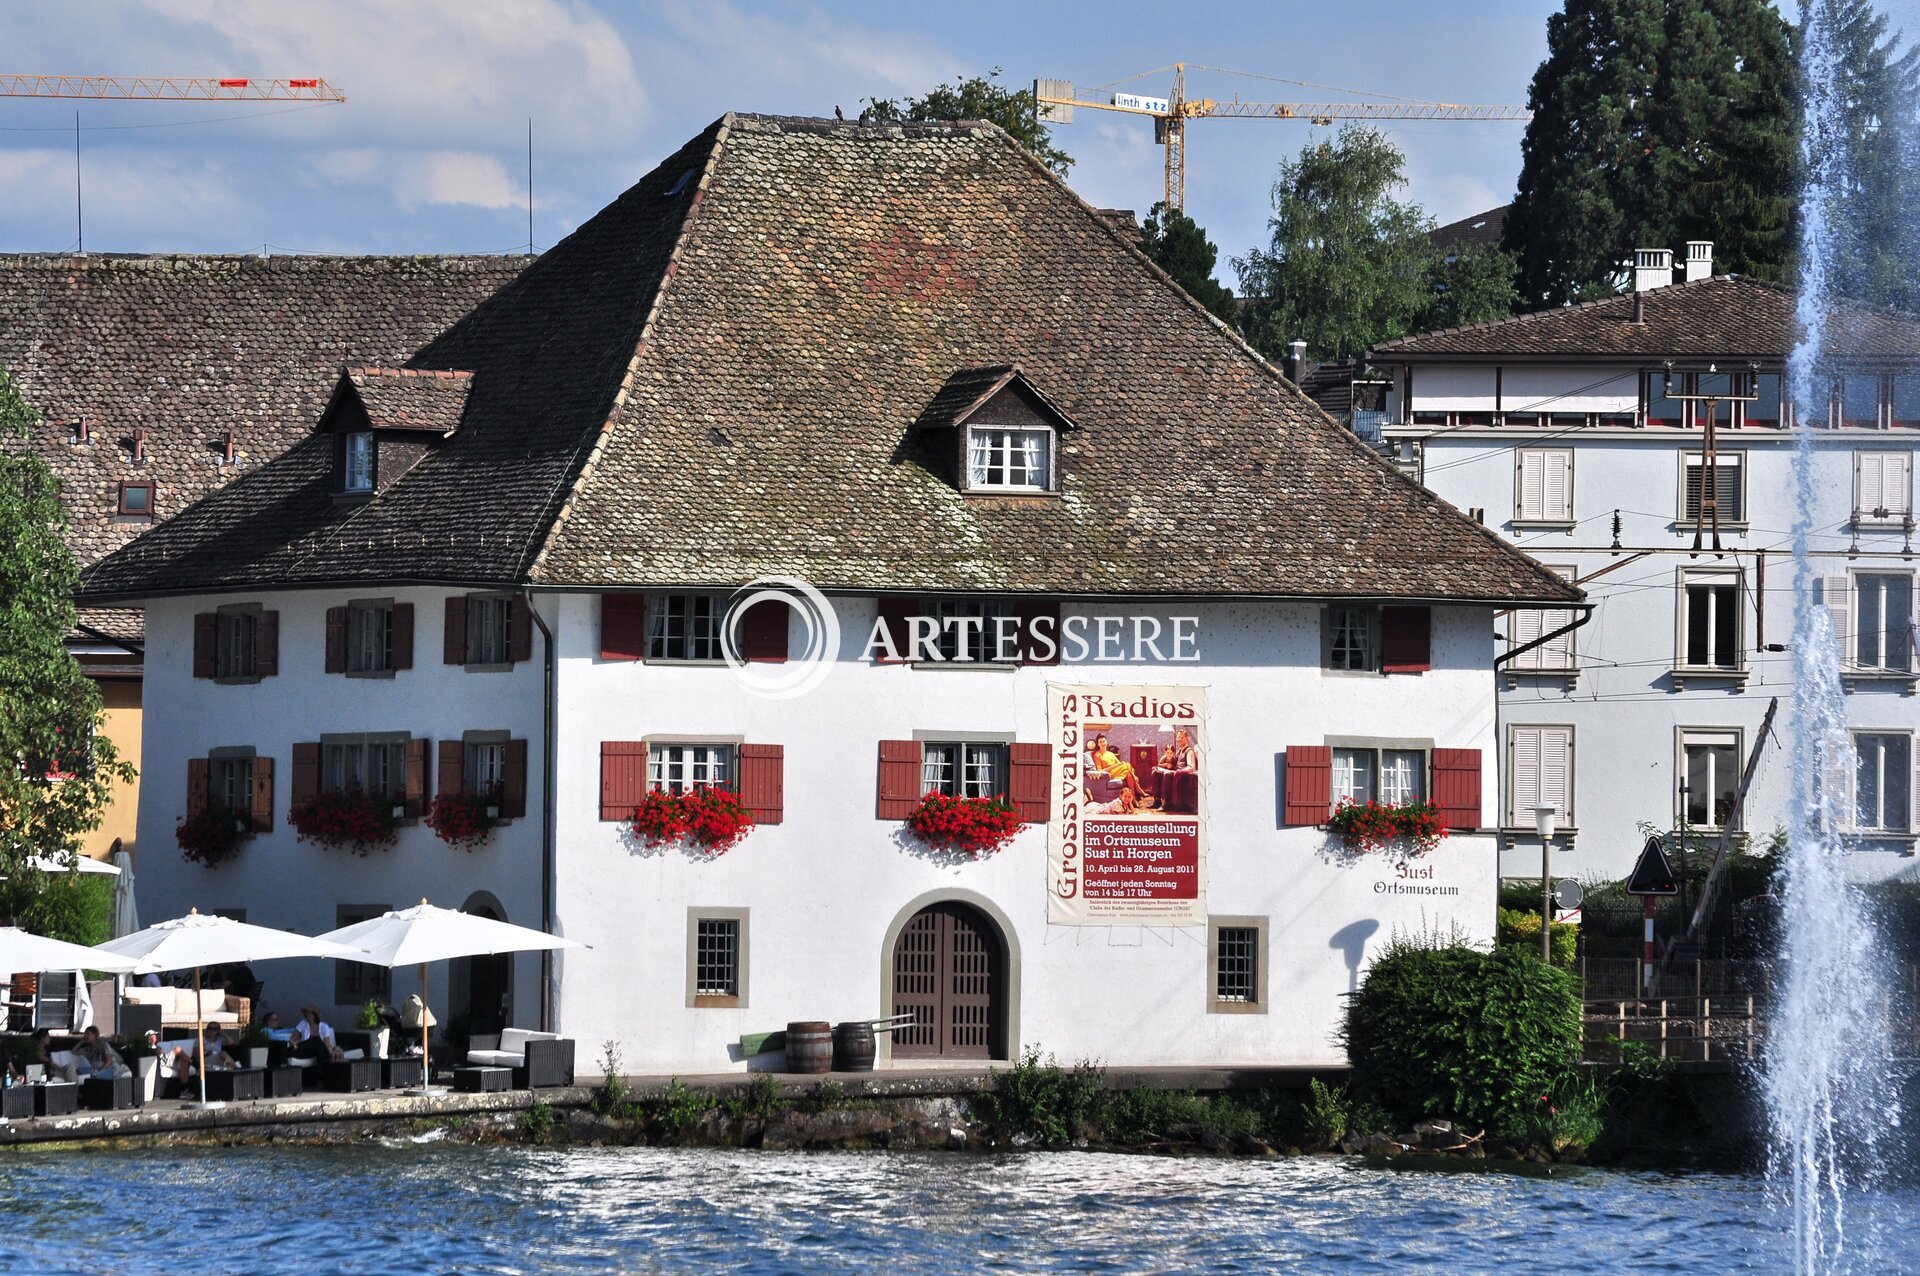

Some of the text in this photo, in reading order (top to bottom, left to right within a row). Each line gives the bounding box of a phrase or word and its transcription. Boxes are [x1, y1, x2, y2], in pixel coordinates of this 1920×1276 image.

[1117, 95, 1140, 108] linth
[1081, 694, 1195, 719] Radios
[1057, 693, 1077, 900] Grossvaters
[1084, 821, 1197, 837] Sonderausstellung
[1085, 834, 1181, 847] im Ortsmuseum
[1085, 847, 1172, 862] Sust in Horgen
[1085, 864, 1195, 875] 10. April bis 28. August 2011
[1395, 862, 1434, 880] Sust
[1084, 879, 1177, 889] Geöffnet jeden Sonntag
[1373, 881, 1459, 896] Ortsmuseum
[1102, 889, 1110, 897] 14
[1112, 889, 1125, 897] bis
[1126, 889, 1135, 897] 17
[1137, 889, 1152, 897] Uhr
